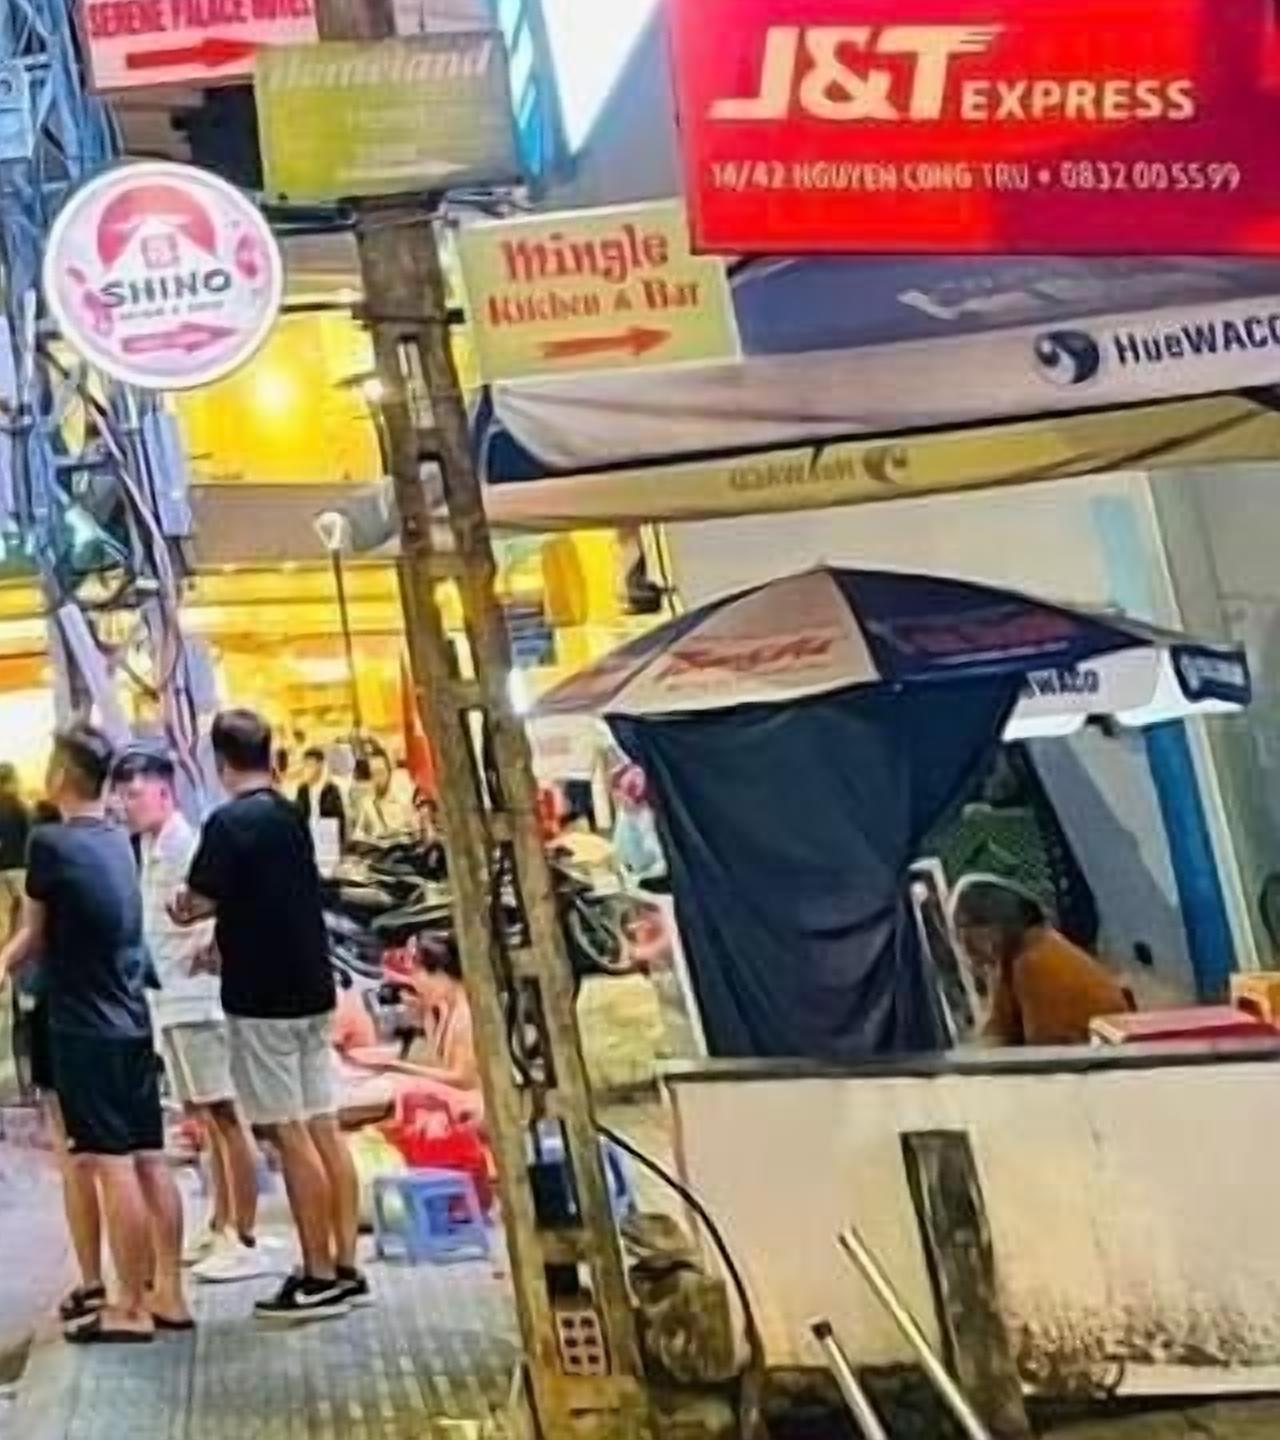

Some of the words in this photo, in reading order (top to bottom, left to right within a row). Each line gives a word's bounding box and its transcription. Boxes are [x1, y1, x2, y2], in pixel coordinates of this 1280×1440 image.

[706, 24, 1008, 122] J&T
[959, 78, 1198, 122] EXPRESS
[501, 222, 669, 285] Mingle
[100, 267, 233, 309] SHINO
